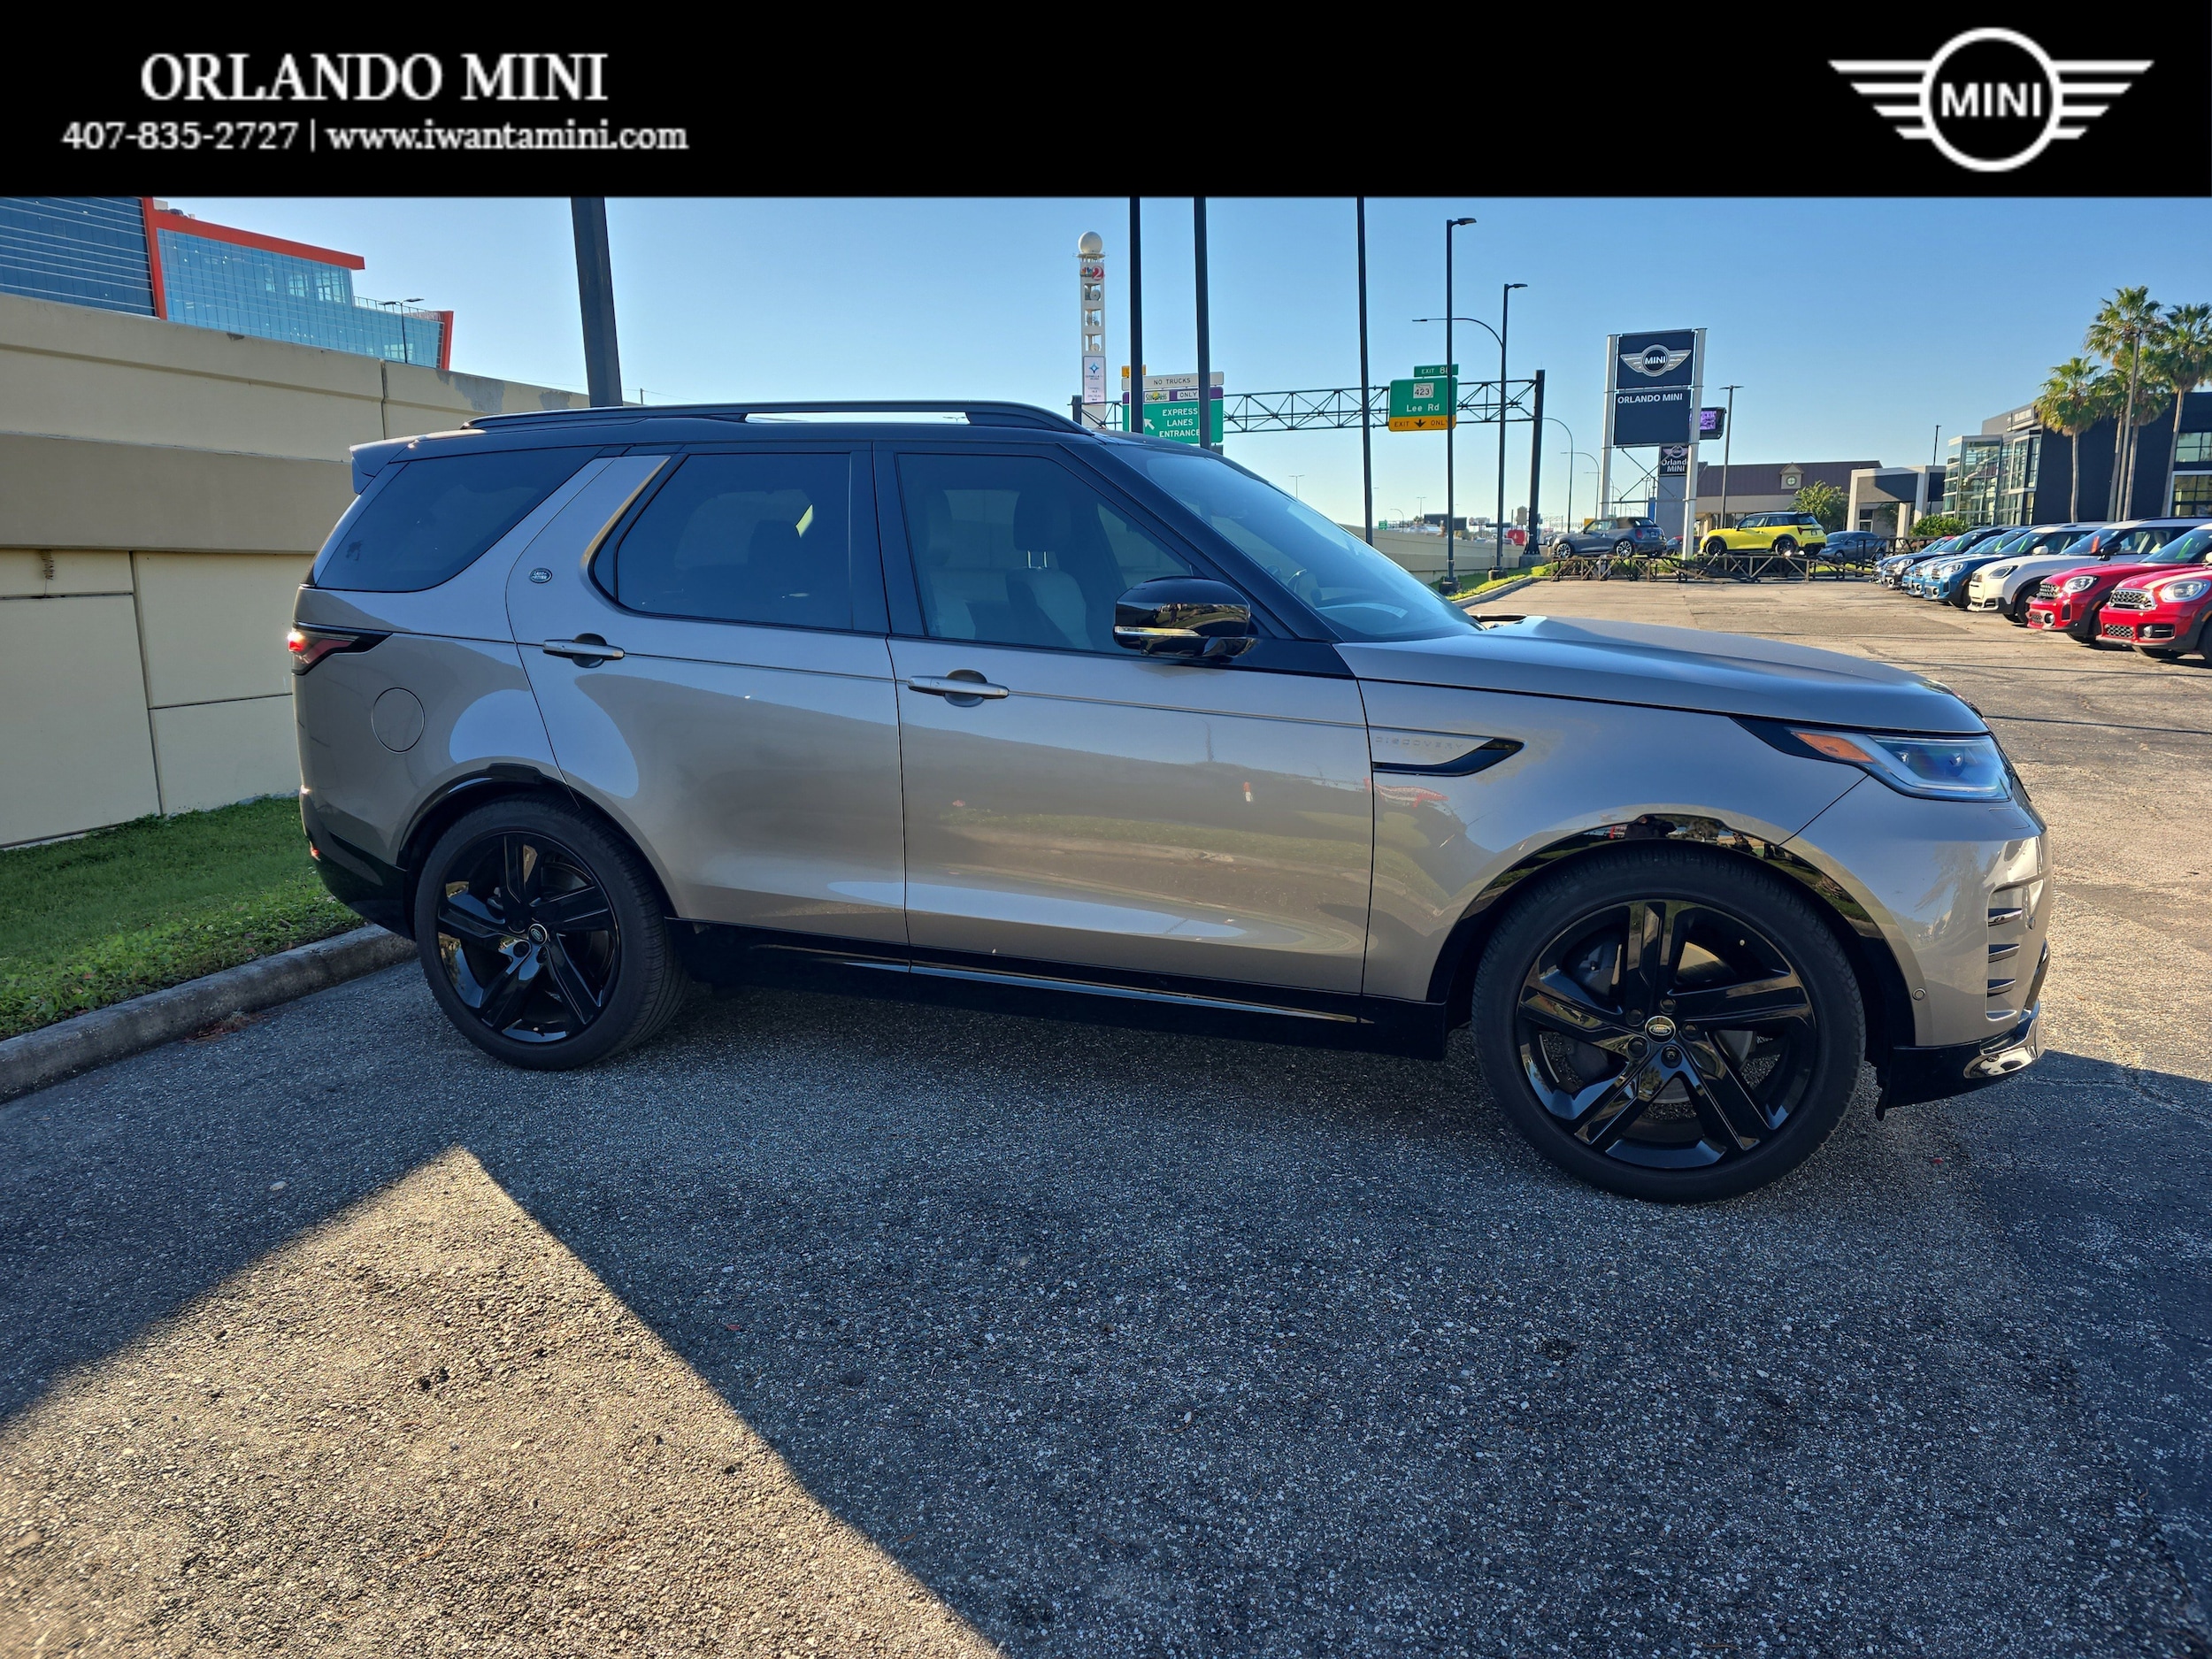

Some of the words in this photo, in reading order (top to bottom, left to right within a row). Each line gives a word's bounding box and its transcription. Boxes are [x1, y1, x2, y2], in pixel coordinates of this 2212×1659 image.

[1645, 356, 1666, 365] MINI
[1617, 395, 1661, 403] ORLANDO
[1663, 393, 1683, 402] MINI
[1162, 408, 1198, 417] EXPRESS
